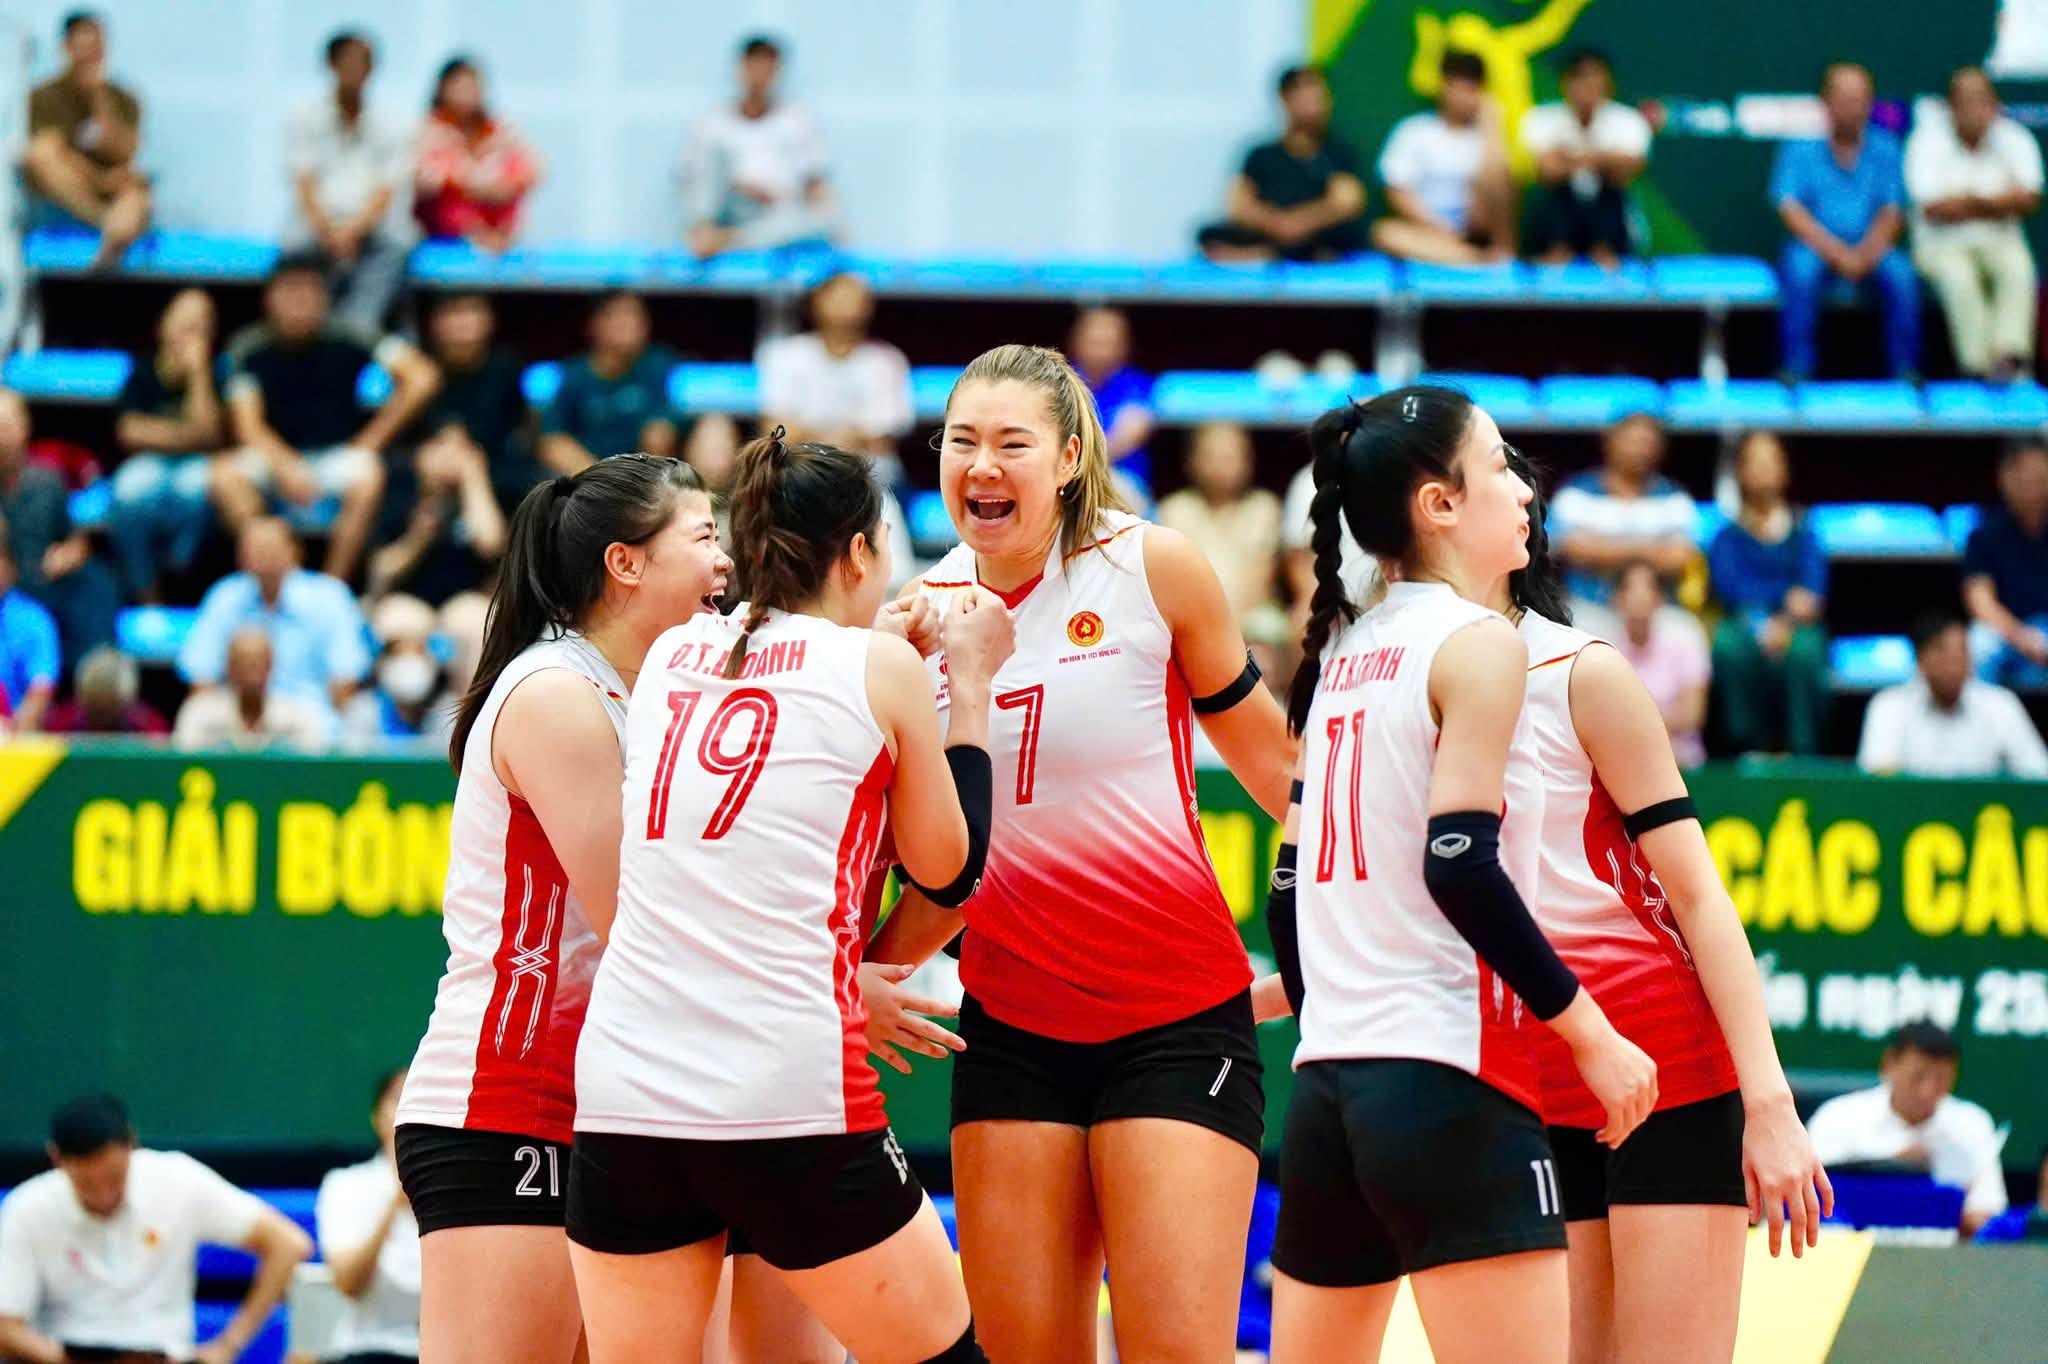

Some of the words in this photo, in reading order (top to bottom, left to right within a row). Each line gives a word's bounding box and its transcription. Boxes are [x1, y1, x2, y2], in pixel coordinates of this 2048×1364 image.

[667, 640, 807, 680] Đ.T.LOANH
[647, 688, 778, 840] 19
[996, 684, 1044, 805] 7
[1316, 709, 1368, 883] 11
[73, 767, 258, 915] GIẢI
[277, 781, 456, 916] BÓN
[1703, 799, 1880, 933] CÁC
[514, 1146, 559, 1197] 21
[1530, 1159, 1559, 1216] 11
